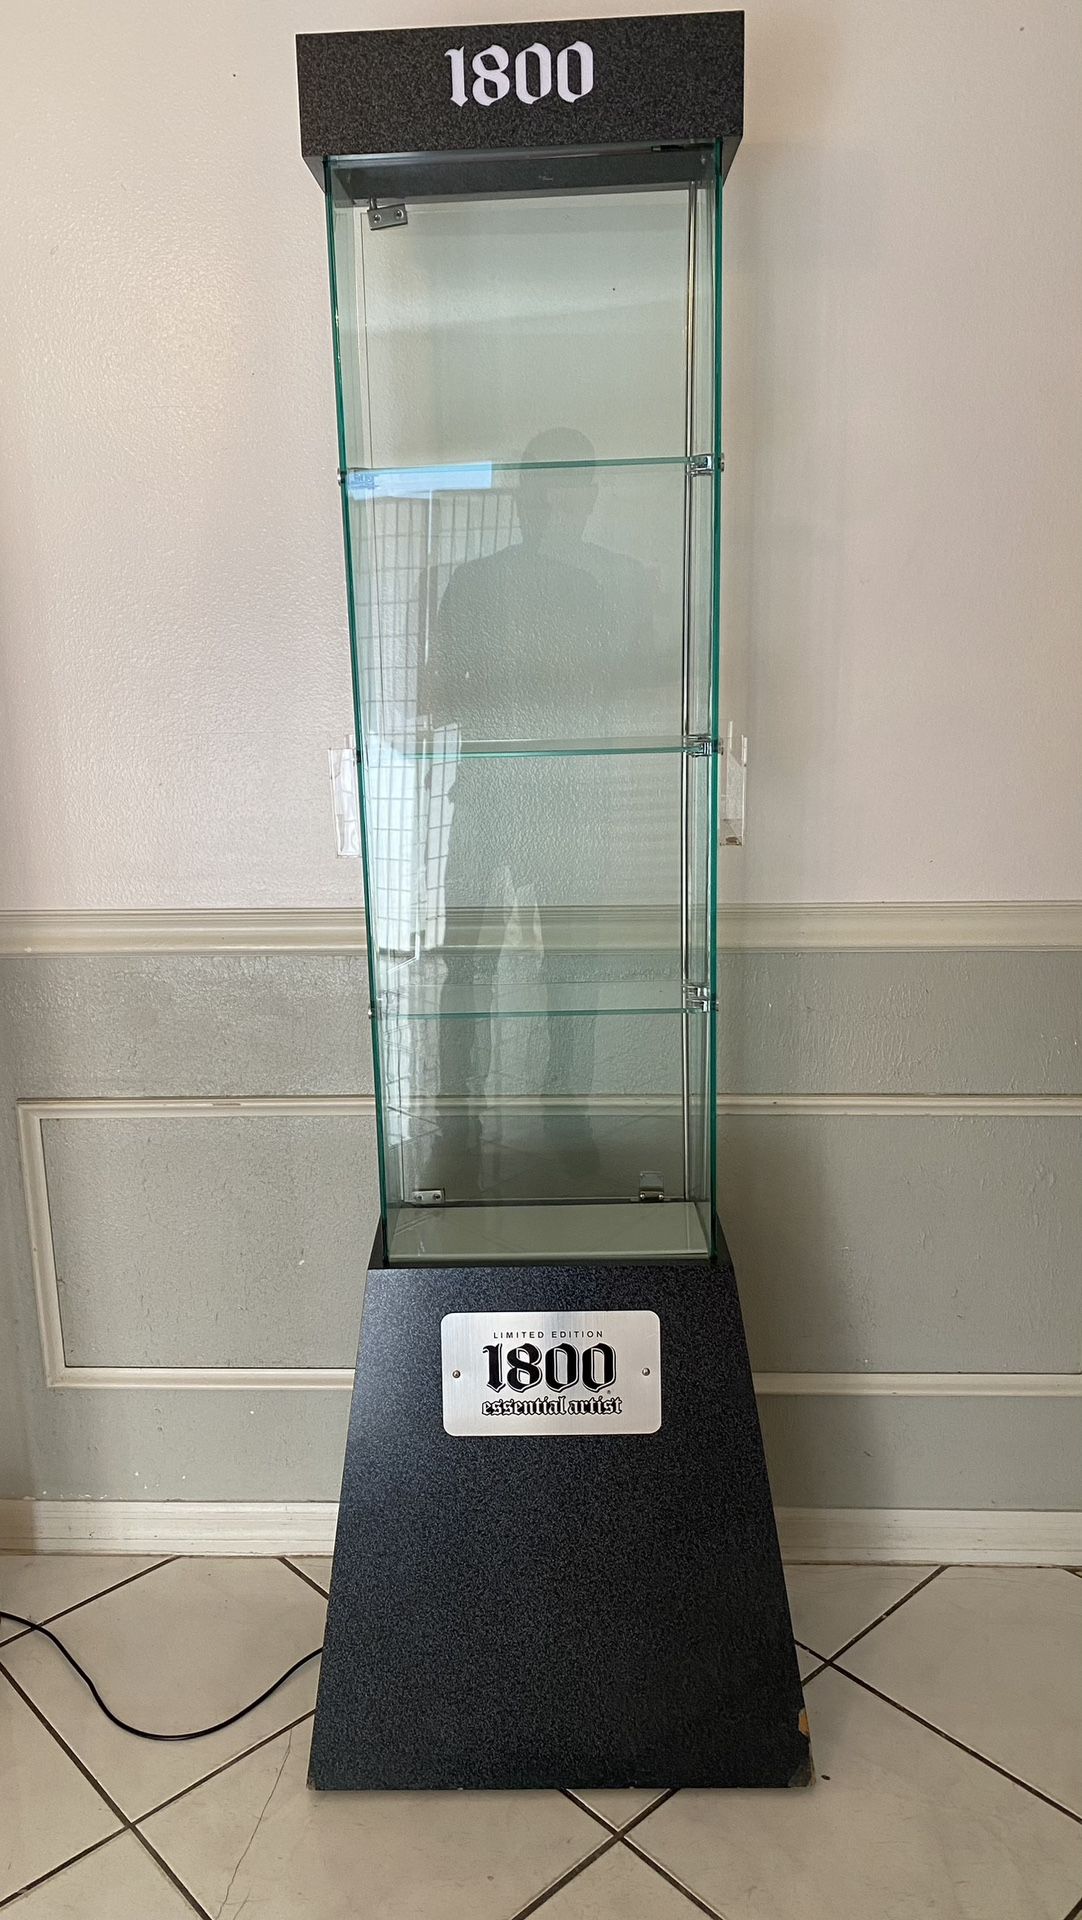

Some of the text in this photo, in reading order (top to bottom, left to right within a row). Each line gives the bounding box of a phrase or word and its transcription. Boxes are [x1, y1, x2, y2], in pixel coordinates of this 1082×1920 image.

[444, 40, 594, 107] 1800
[493, 1330, 604, 1339] LIMITED EDITION
[482, 1342, 617, 1393] 1800
[481, 1395, 623, 1416] essential artist
